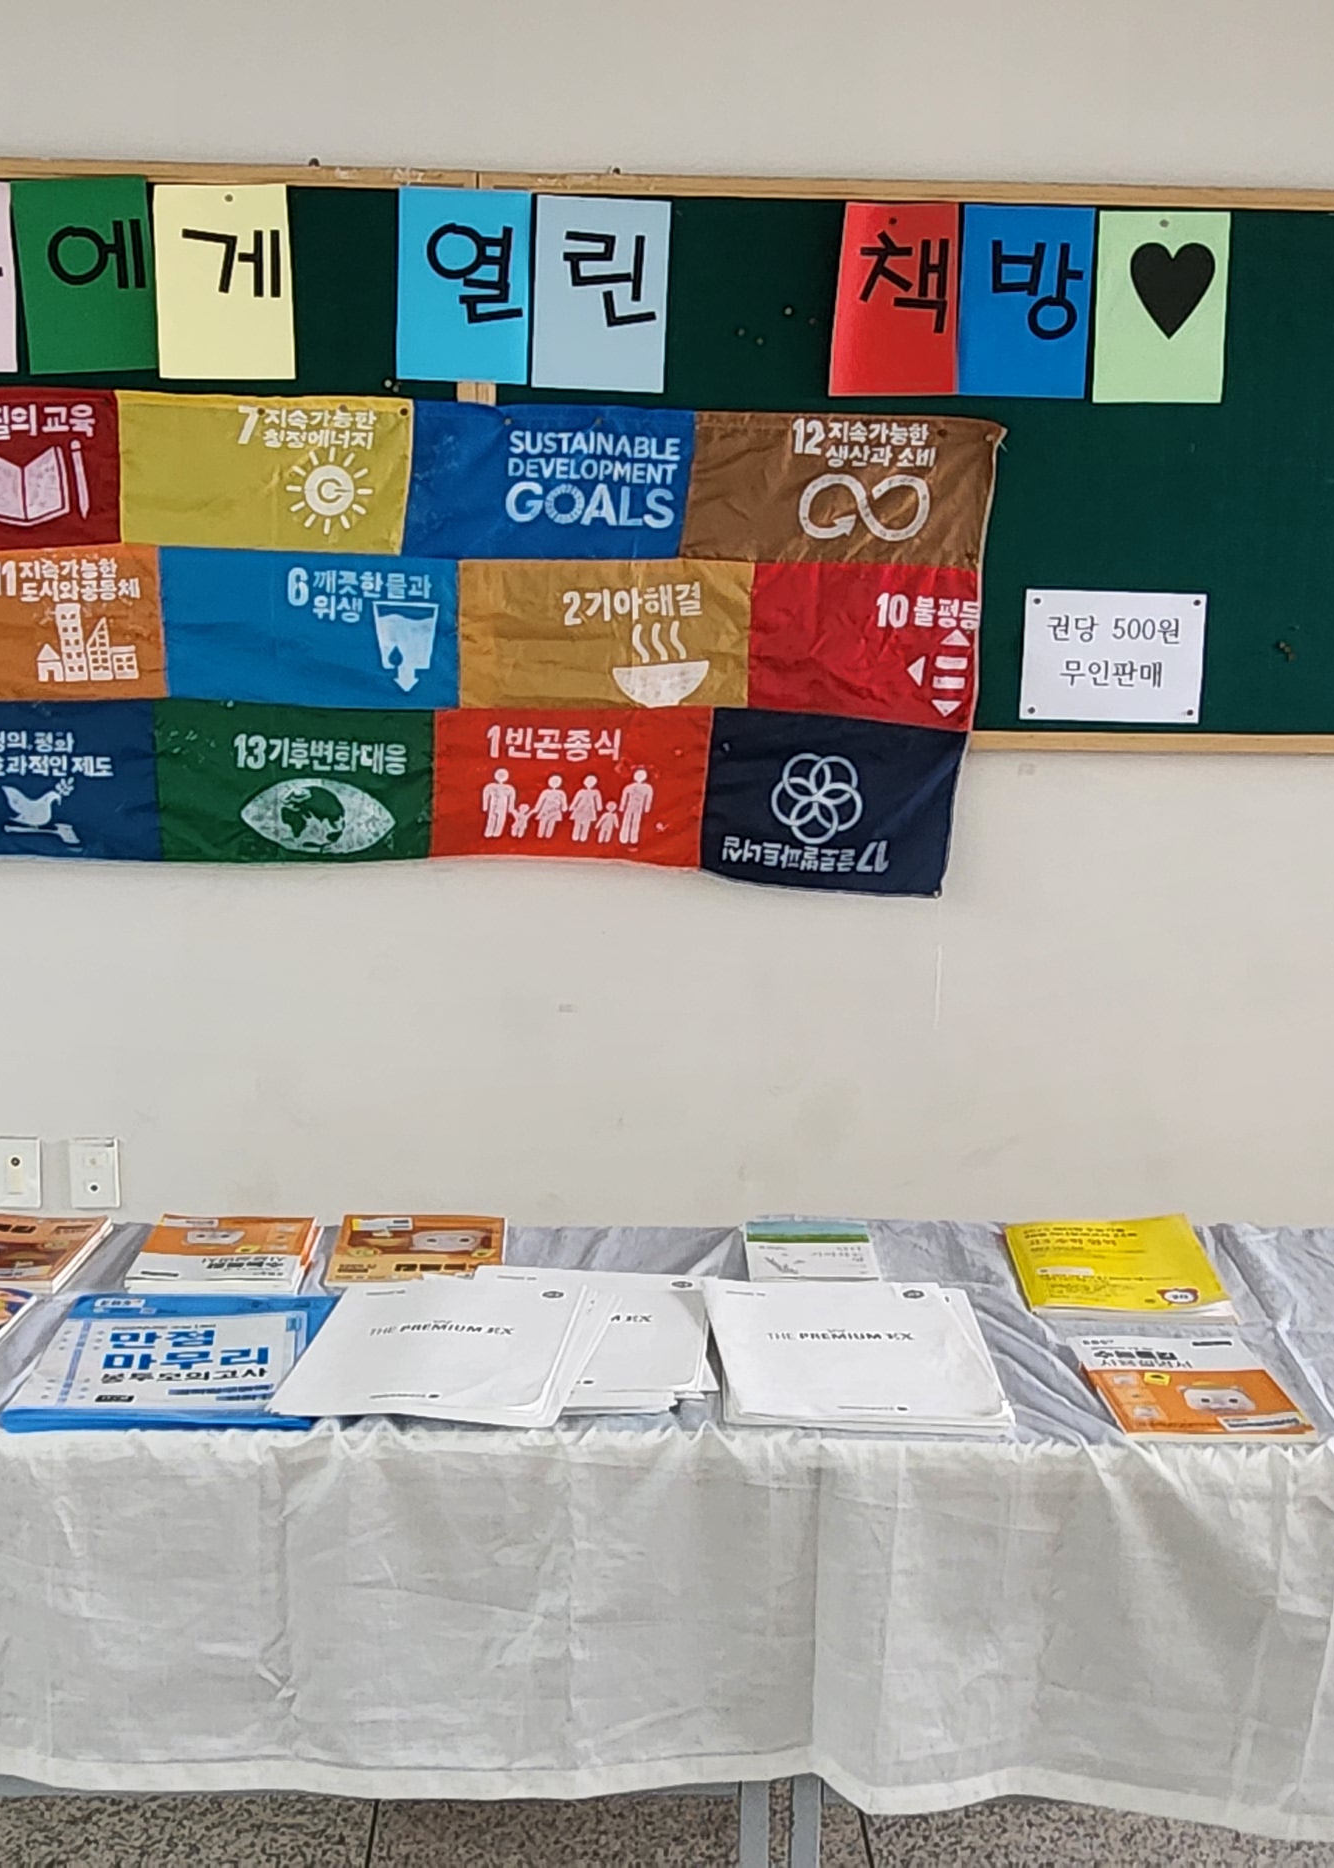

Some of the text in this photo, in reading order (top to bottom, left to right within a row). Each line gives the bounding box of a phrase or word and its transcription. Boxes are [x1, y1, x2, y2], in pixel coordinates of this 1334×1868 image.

[426, 222, 656, 327] 열린
[859, 230, 1084, 341] 책방
[238, 405, 260, 444] 7
[792, 418, 826, 455] 12
[828, 421, 929, 446] 지속가능한
[509, 430, 681, 461] SUSTAINABLE
[825, 445, 936, 467] 생산과 소비
[507, 457, 678, 485] DEVELOPMENT
[505, 481, 675, 529] GOALS
[18, 557, 117, 580] 지속가능한
[288, 567, 309, 607] 6
[312, 595, 363, 623] 위생
[876, 592, 980, 630] 10 불평등
[1047, 615, 1180, 645] 권당 500원
[1060, 660, 1163, 688] 무인판매
[110, 1330, 215, 1349] 만점
[399, 1323, 483, 1334] PREMIUM
[798, 1332, 882, 1341] PREMIUM
